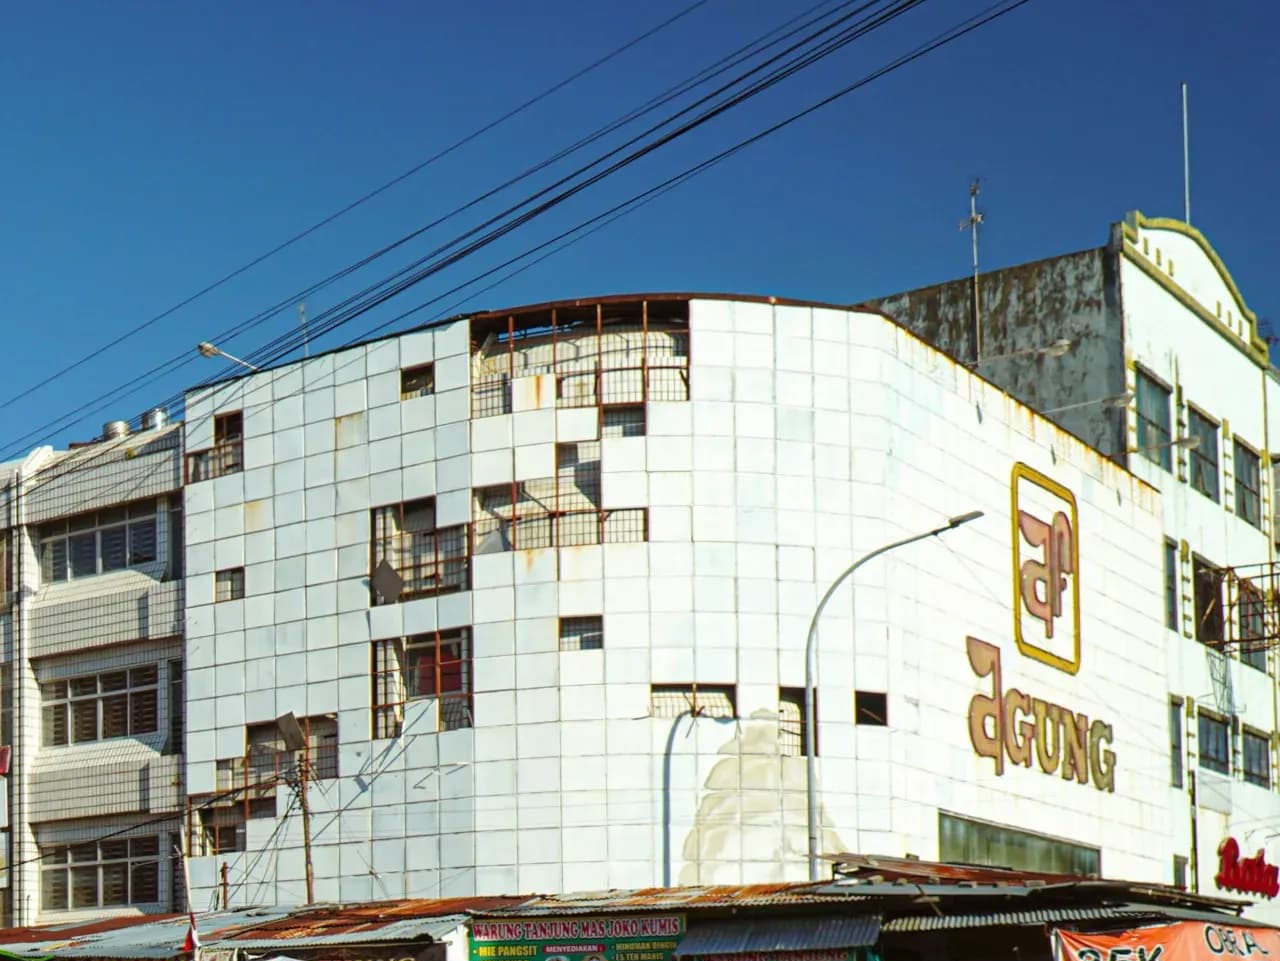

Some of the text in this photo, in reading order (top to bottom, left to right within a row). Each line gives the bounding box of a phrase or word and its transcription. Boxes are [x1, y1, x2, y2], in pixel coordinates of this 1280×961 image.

[473, 917, 680, 941] WARUNG TANJUNG MAS JOKO KUMIS
[479, 945, 538, 957] MIE PANGSIT
